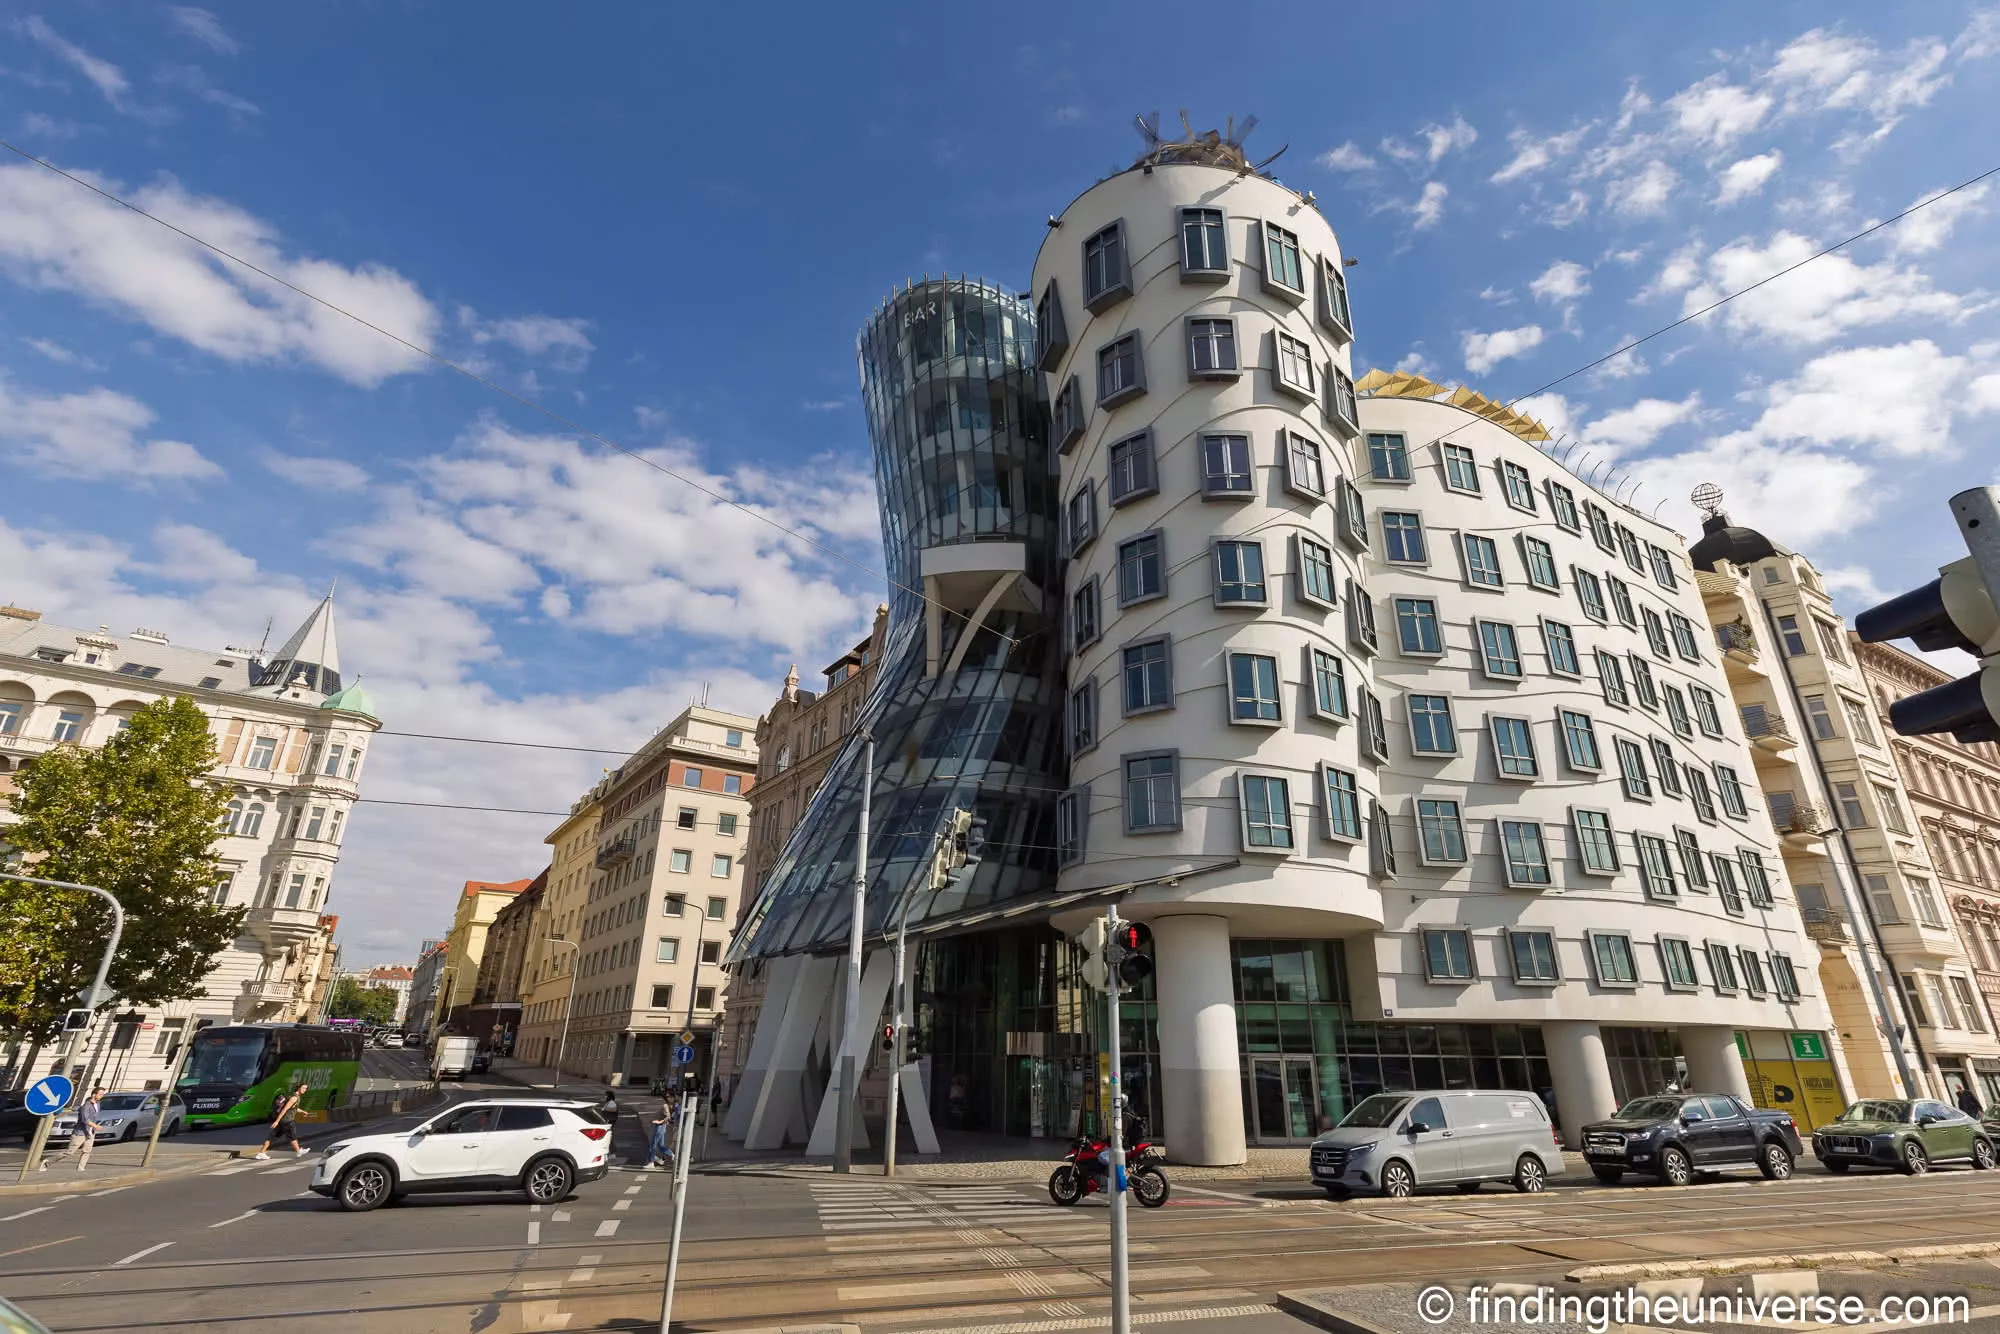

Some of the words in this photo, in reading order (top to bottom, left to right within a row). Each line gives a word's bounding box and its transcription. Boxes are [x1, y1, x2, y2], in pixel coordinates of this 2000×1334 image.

[904, 301, 937, 328] BAR
[291, 1067, 333, 1090] FLIXBUS
[192, 1102, 220, 1110] FLIXBUS
